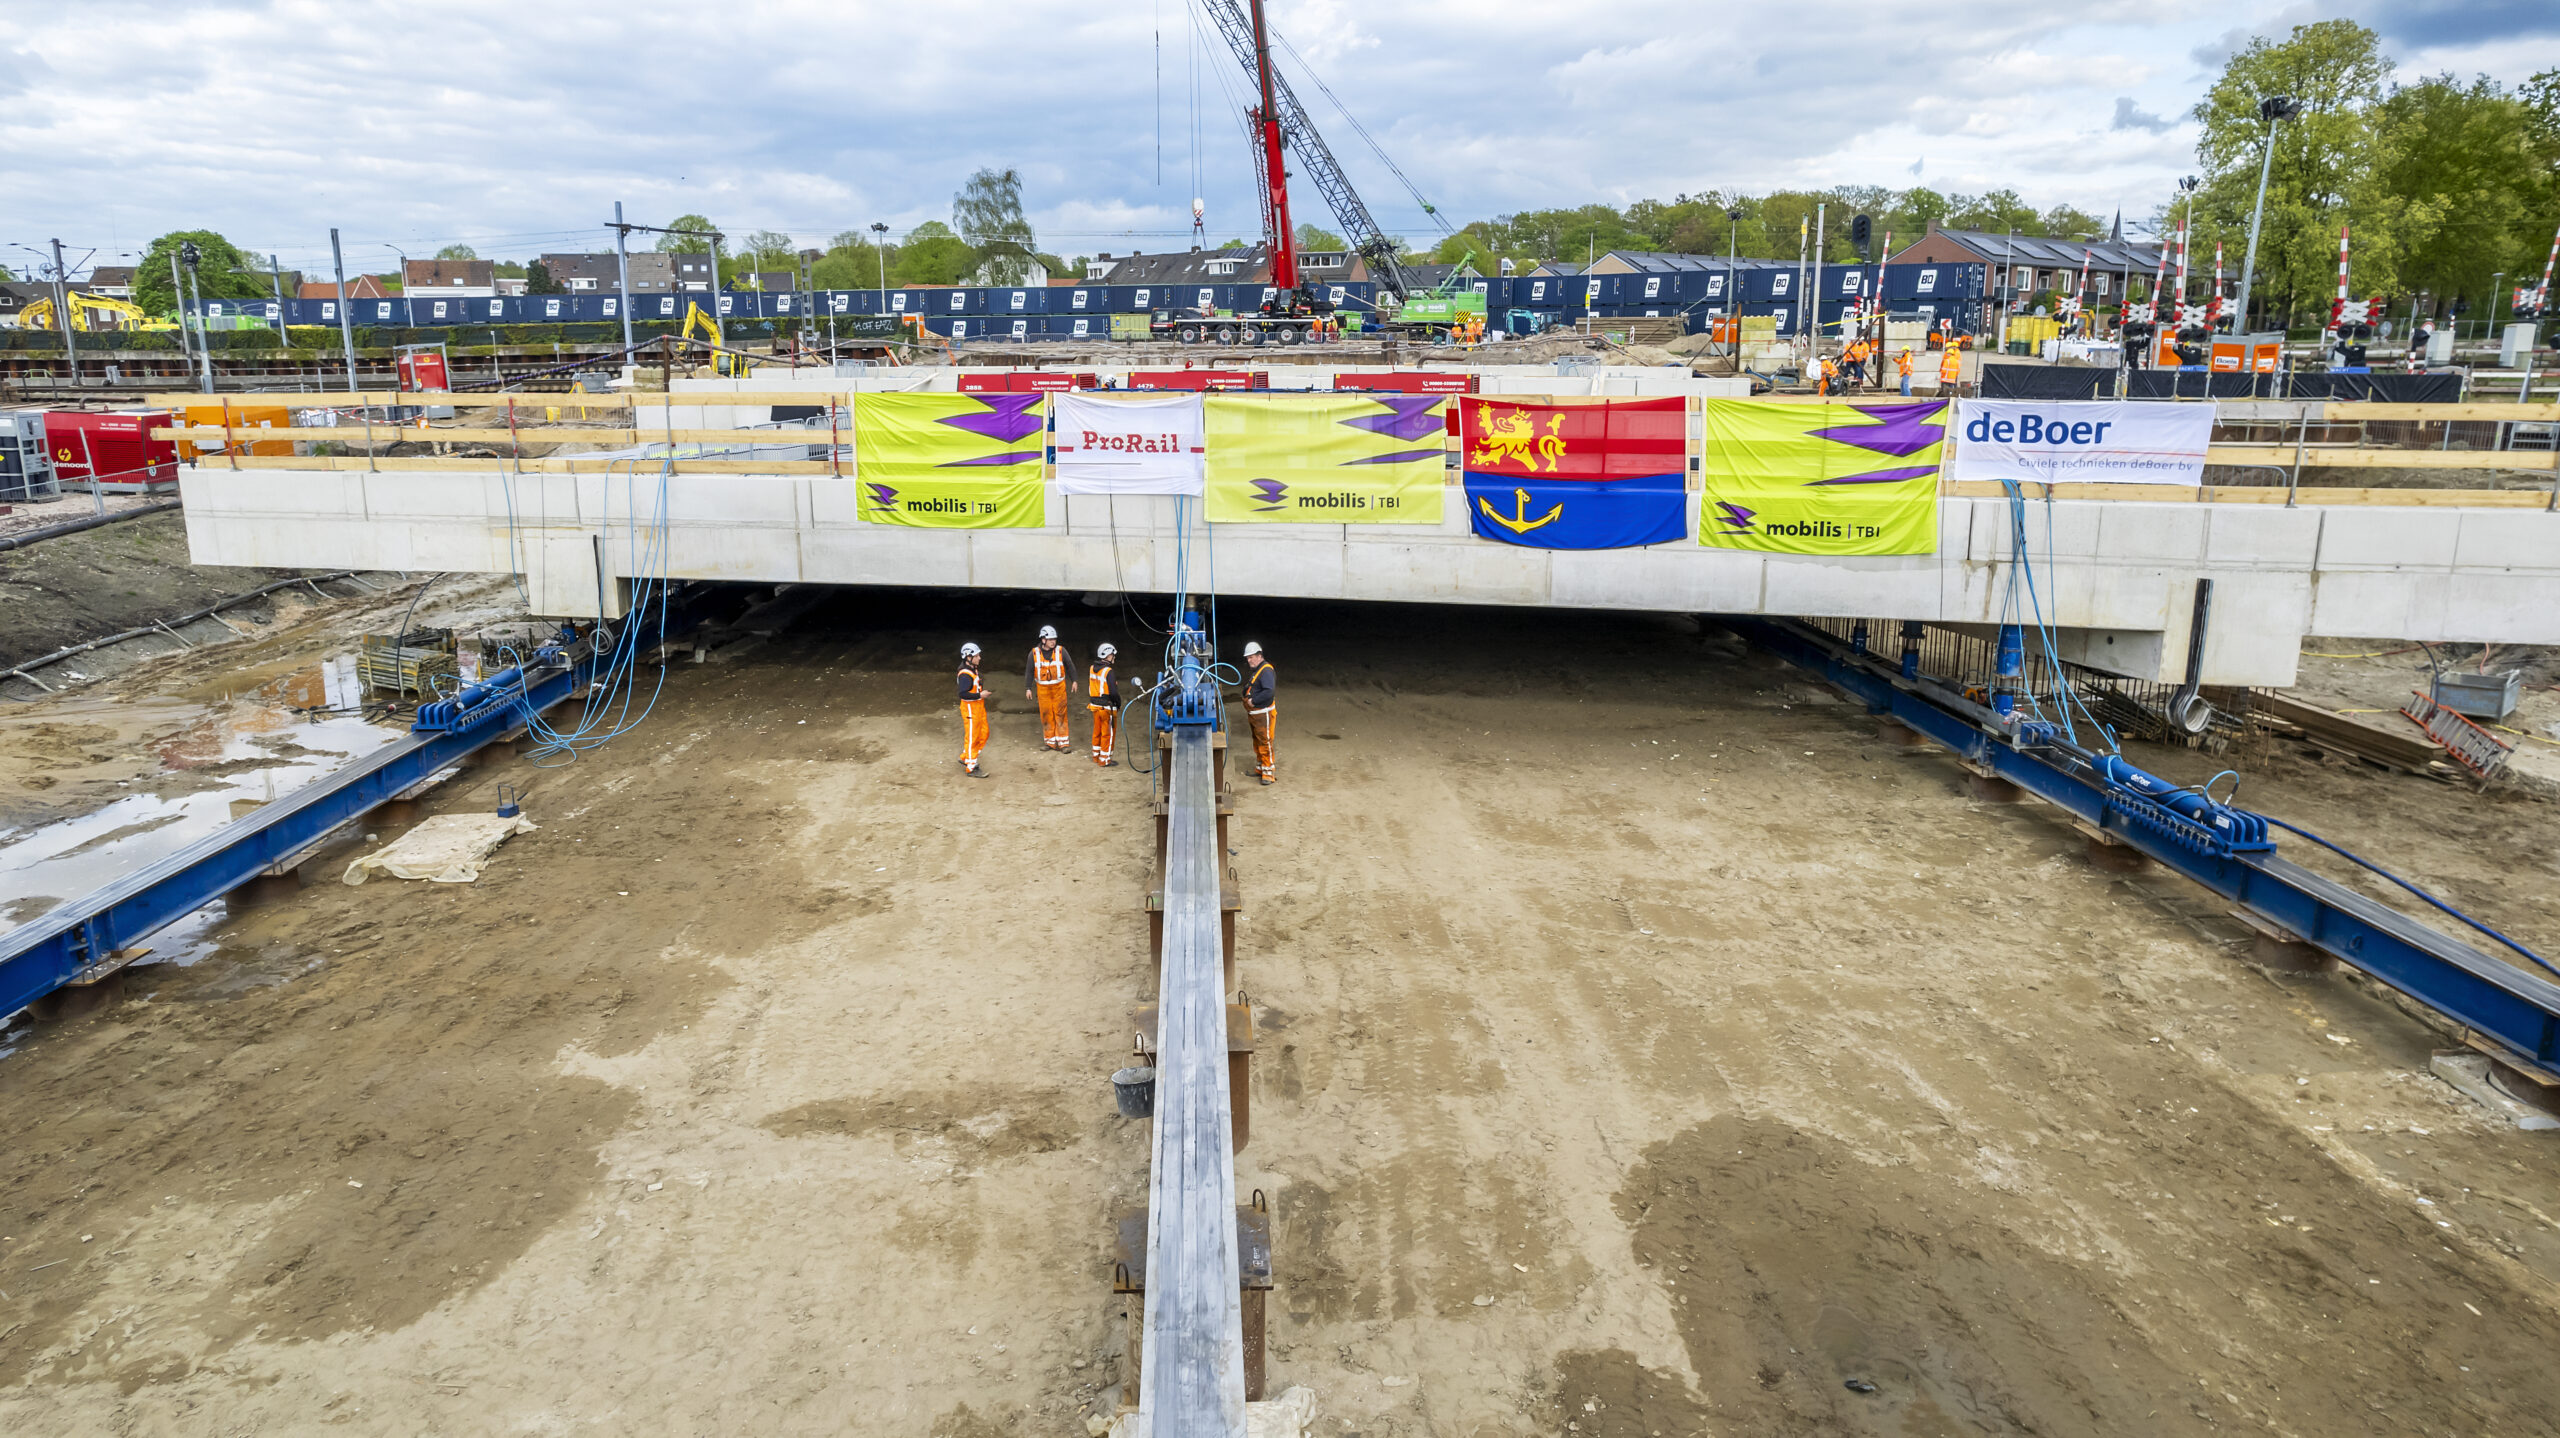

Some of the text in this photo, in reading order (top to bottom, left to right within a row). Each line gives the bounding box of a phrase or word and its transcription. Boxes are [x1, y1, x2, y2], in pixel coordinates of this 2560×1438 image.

[1966, 412, 2112, 444] deBoer
[1082, 430, 1180, 453] ProRail
[2018, 457, 2193, 472] Civiele technieken deBoer bv
[907, 498, 998, 514] mobilis TBI
[1298, 492, 1400, 508] mobilis TBI
[1766, 520, 1880, 538] mobilis TBI
